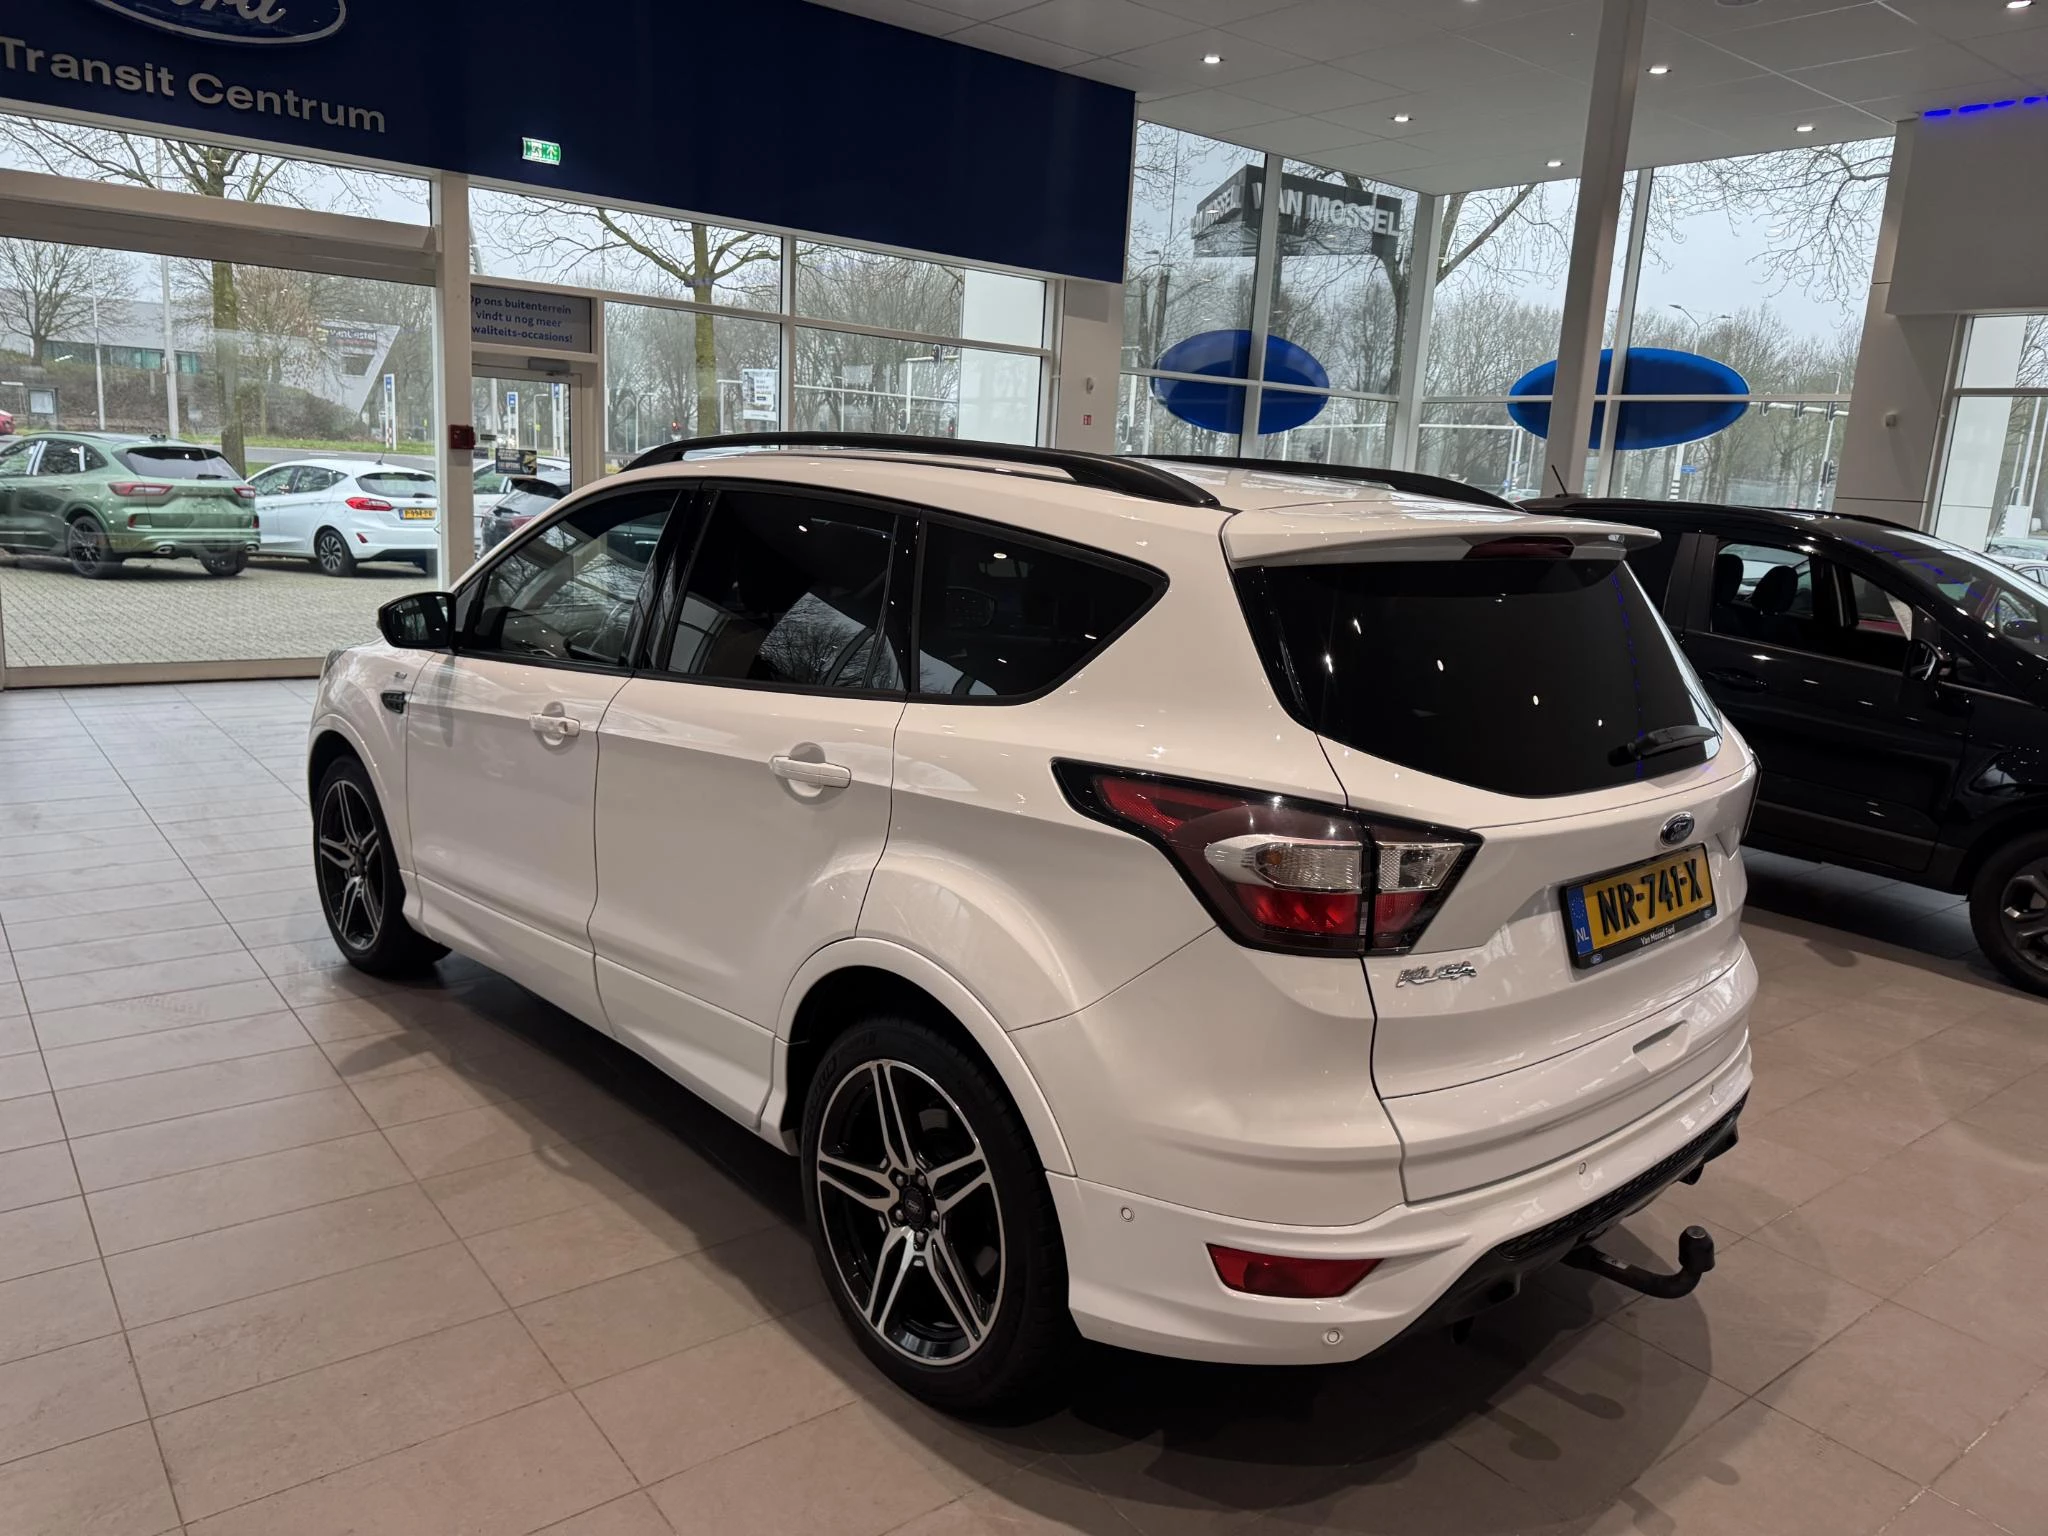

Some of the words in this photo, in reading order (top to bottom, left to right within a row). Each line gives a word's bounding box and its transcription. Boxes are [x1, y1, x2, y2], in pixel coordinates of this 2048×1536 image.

[0, 36, 176, 98] Transit
[188, 73, 387, 134] Centrum
[1306, 194, 1400, 238] MOSSEL
[484, 296, 503, 307] ons
[505, 297, 572, 315] buitenterrein
[475, 310, 503, 321] vindt
[505, 314, 511, 322] u
[514, 315, 534, 327] nog
[536, 318, 562, 328] meer
[470, 324, 573, 343] waliteits-occasions!
[1598, 859, 1703, 936] NR-741-X
[1576, 927, 1590, 942] NL
[1641, 935, 1651, 945] Van
[1665, 924, 1675, 935] Ford
